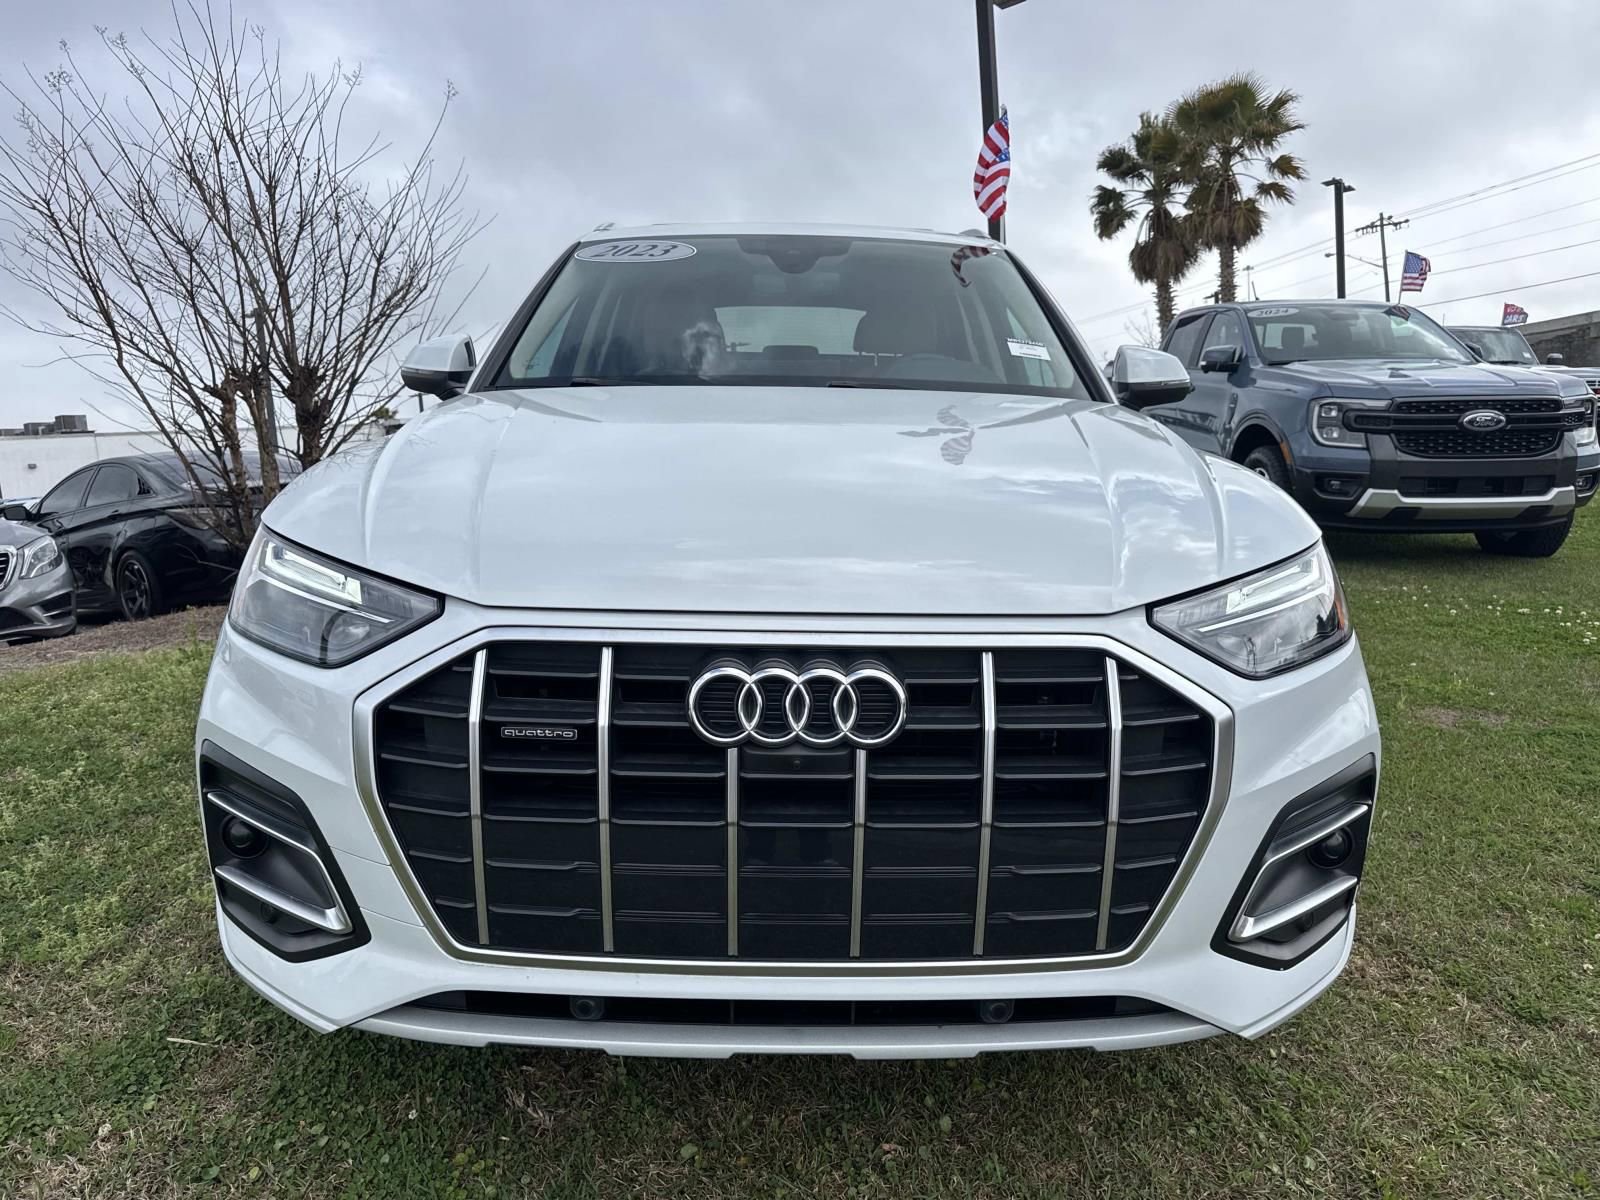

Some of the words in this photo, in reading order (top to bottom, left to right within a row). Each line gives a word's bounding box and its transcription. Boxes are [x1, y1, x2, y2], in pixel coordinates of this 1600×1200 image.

[589, 244, 679, 258] 2023
[1473, 416, 1498, 427] Ford
[504, 729, 574, 738] quattro
